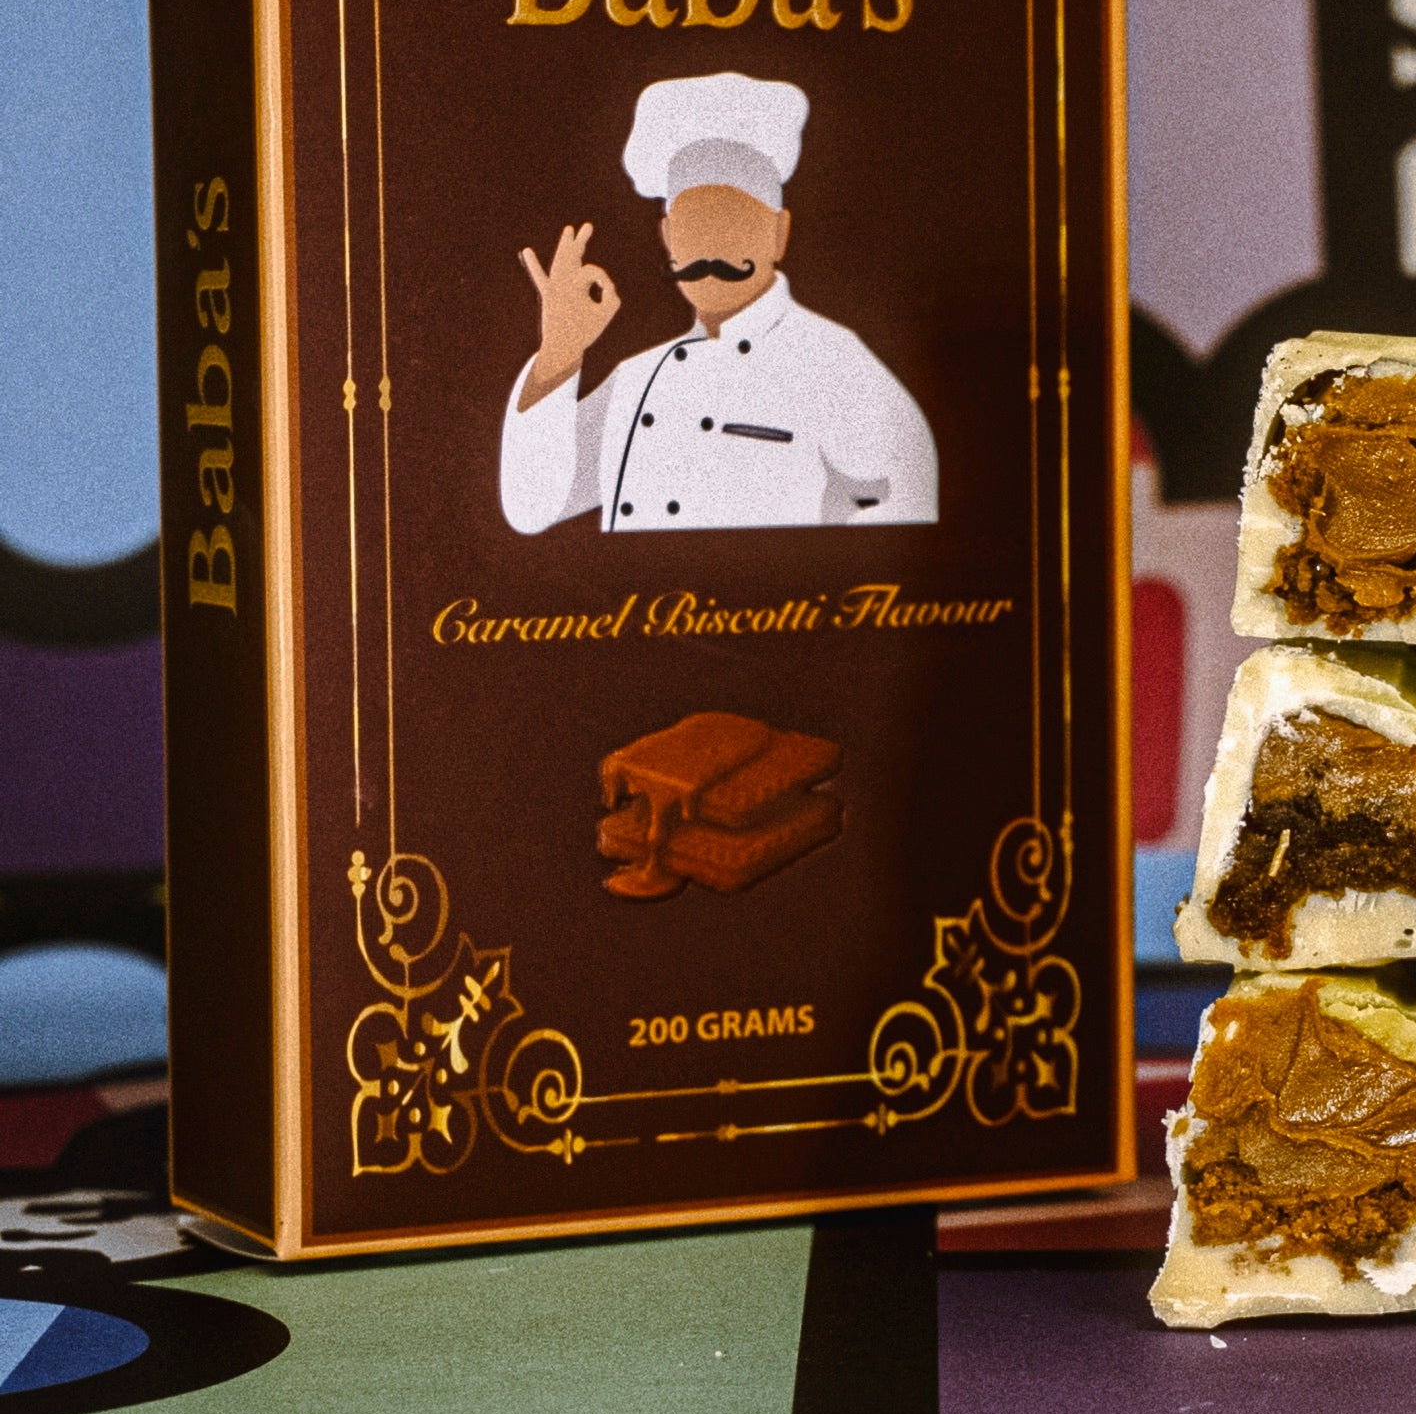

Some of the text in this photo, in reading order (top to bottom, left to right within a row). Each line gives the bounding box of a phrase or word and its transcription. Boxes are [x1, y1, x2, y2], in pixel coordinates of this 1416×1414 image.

[187, 175, 238, 617] Baba's
[431, 583, 1013, 646] Caramel Biscotti Flavour
[628, 1004, 815, 1048] 200 GRAMS
